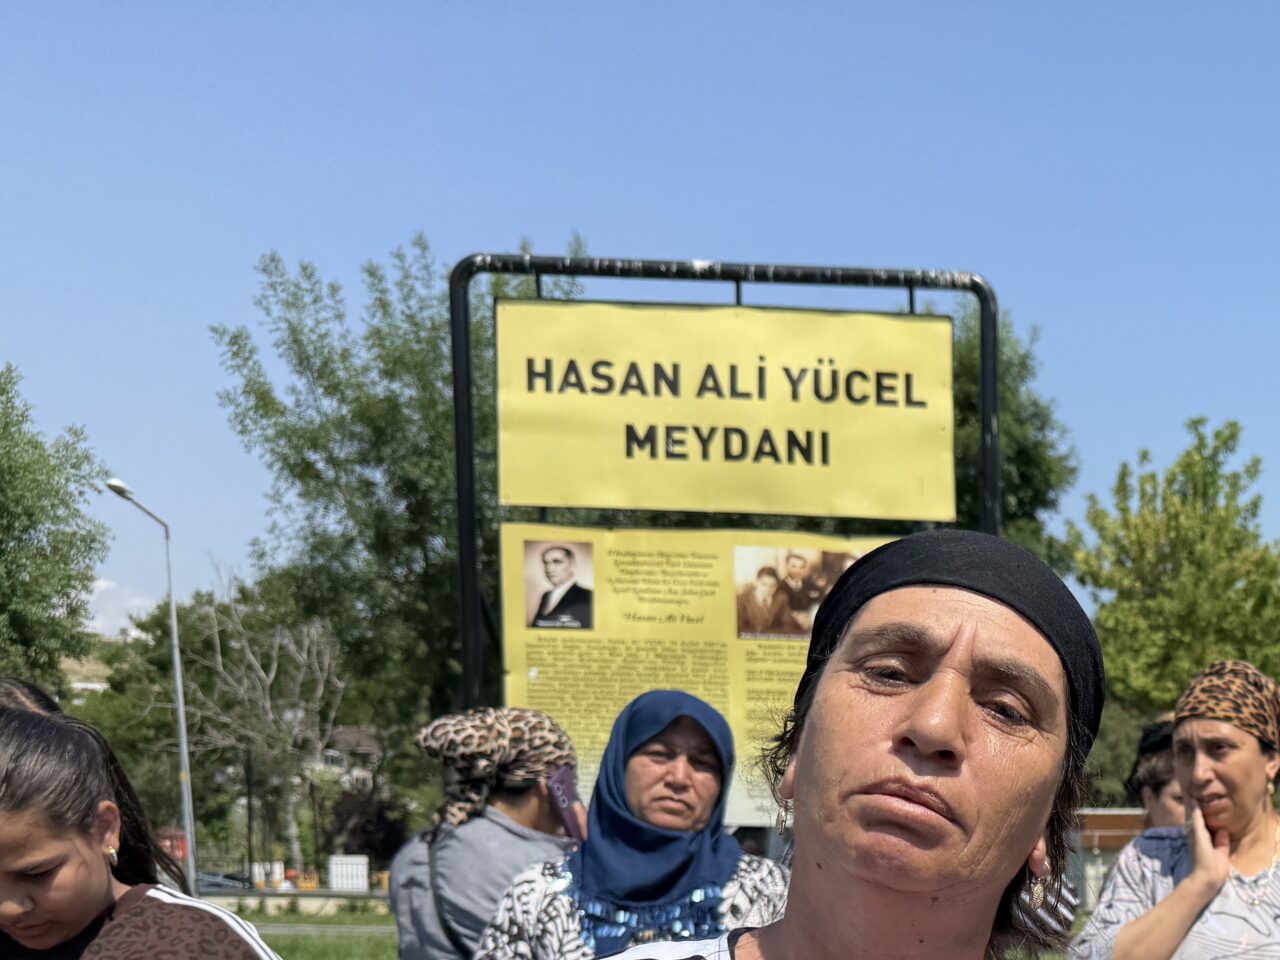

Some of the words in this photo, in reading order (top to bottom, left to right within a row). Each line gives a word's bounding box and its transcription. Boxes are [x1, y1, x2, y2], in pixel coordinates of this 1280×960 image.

[526, 357, 682, 398] HASAN
[695, 354, 767, 400] ALİ
[783, 358, 928, 409] YÜCEL
[624, 424, 831, 467] MEYDANI
